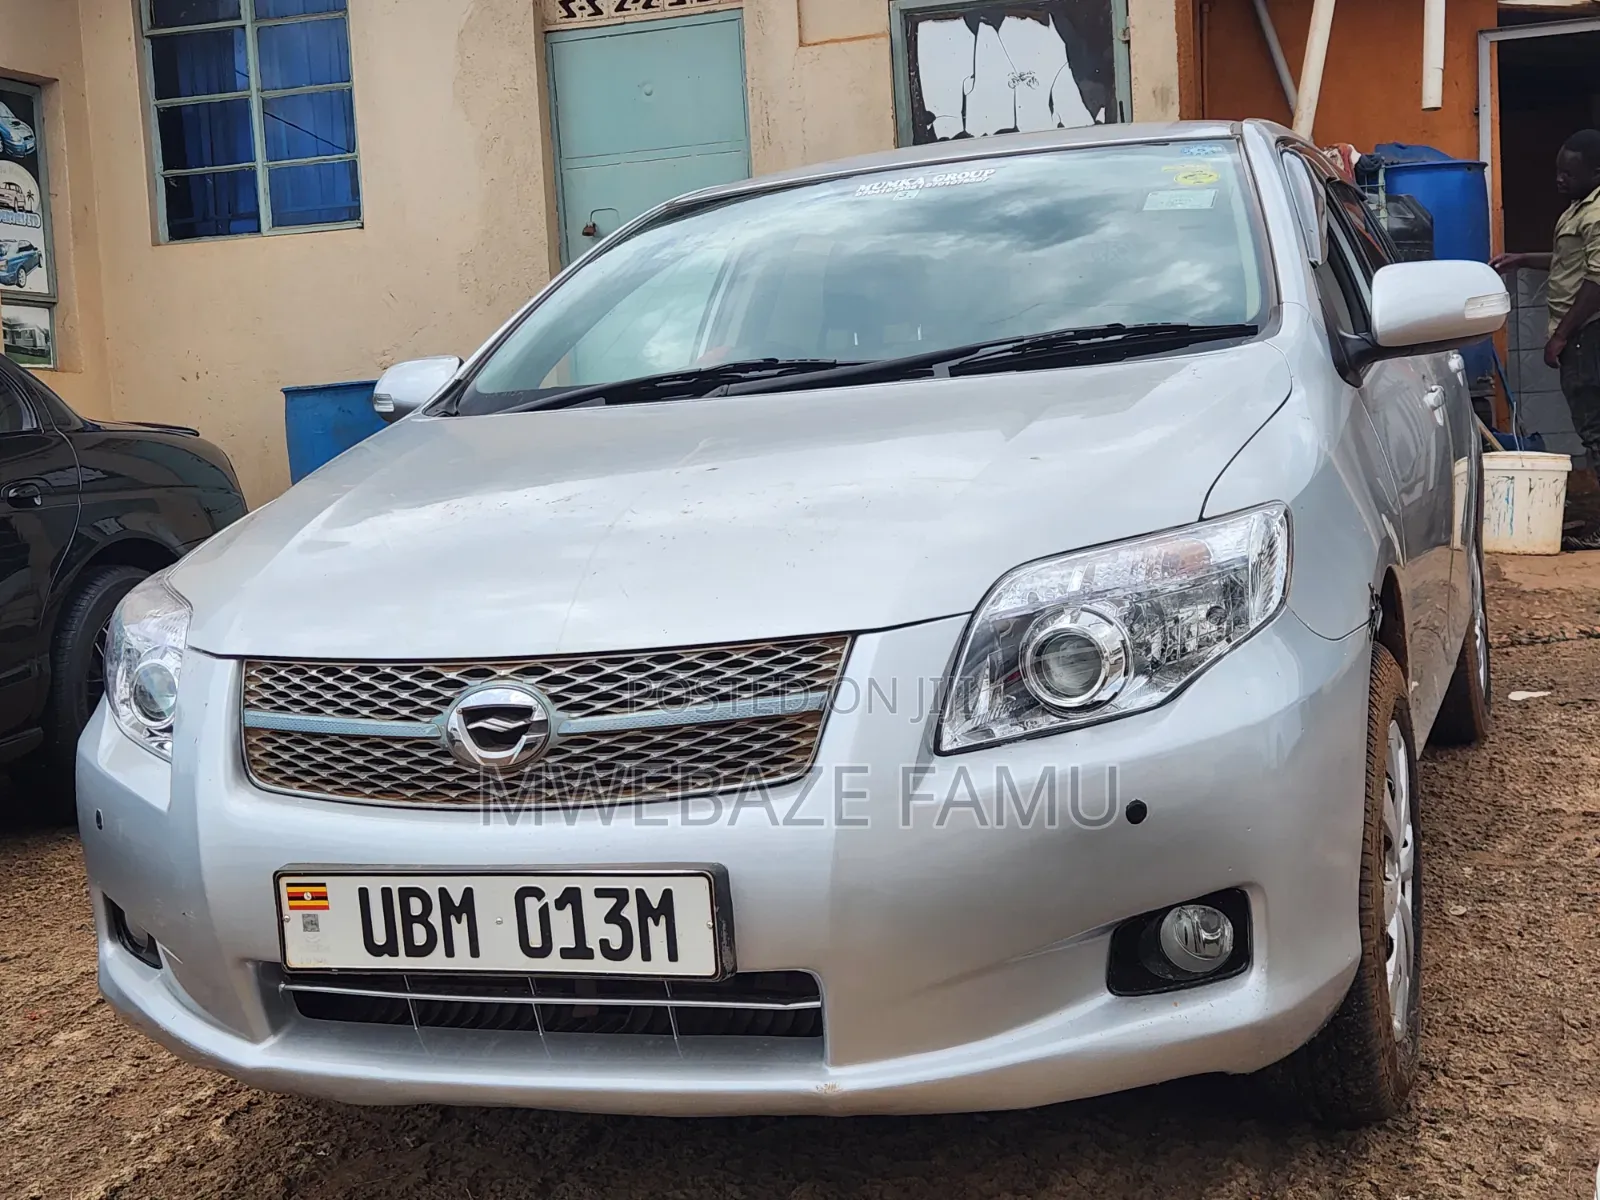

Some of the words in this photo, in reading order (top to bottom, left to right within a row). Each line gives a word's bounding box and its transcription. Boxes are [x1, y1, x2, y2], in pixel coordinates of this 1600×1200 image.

[932, 168, 996, 183] GROUP
[358, 887, 480, 957] UBM
[515, 886, 678, 962] 013M
